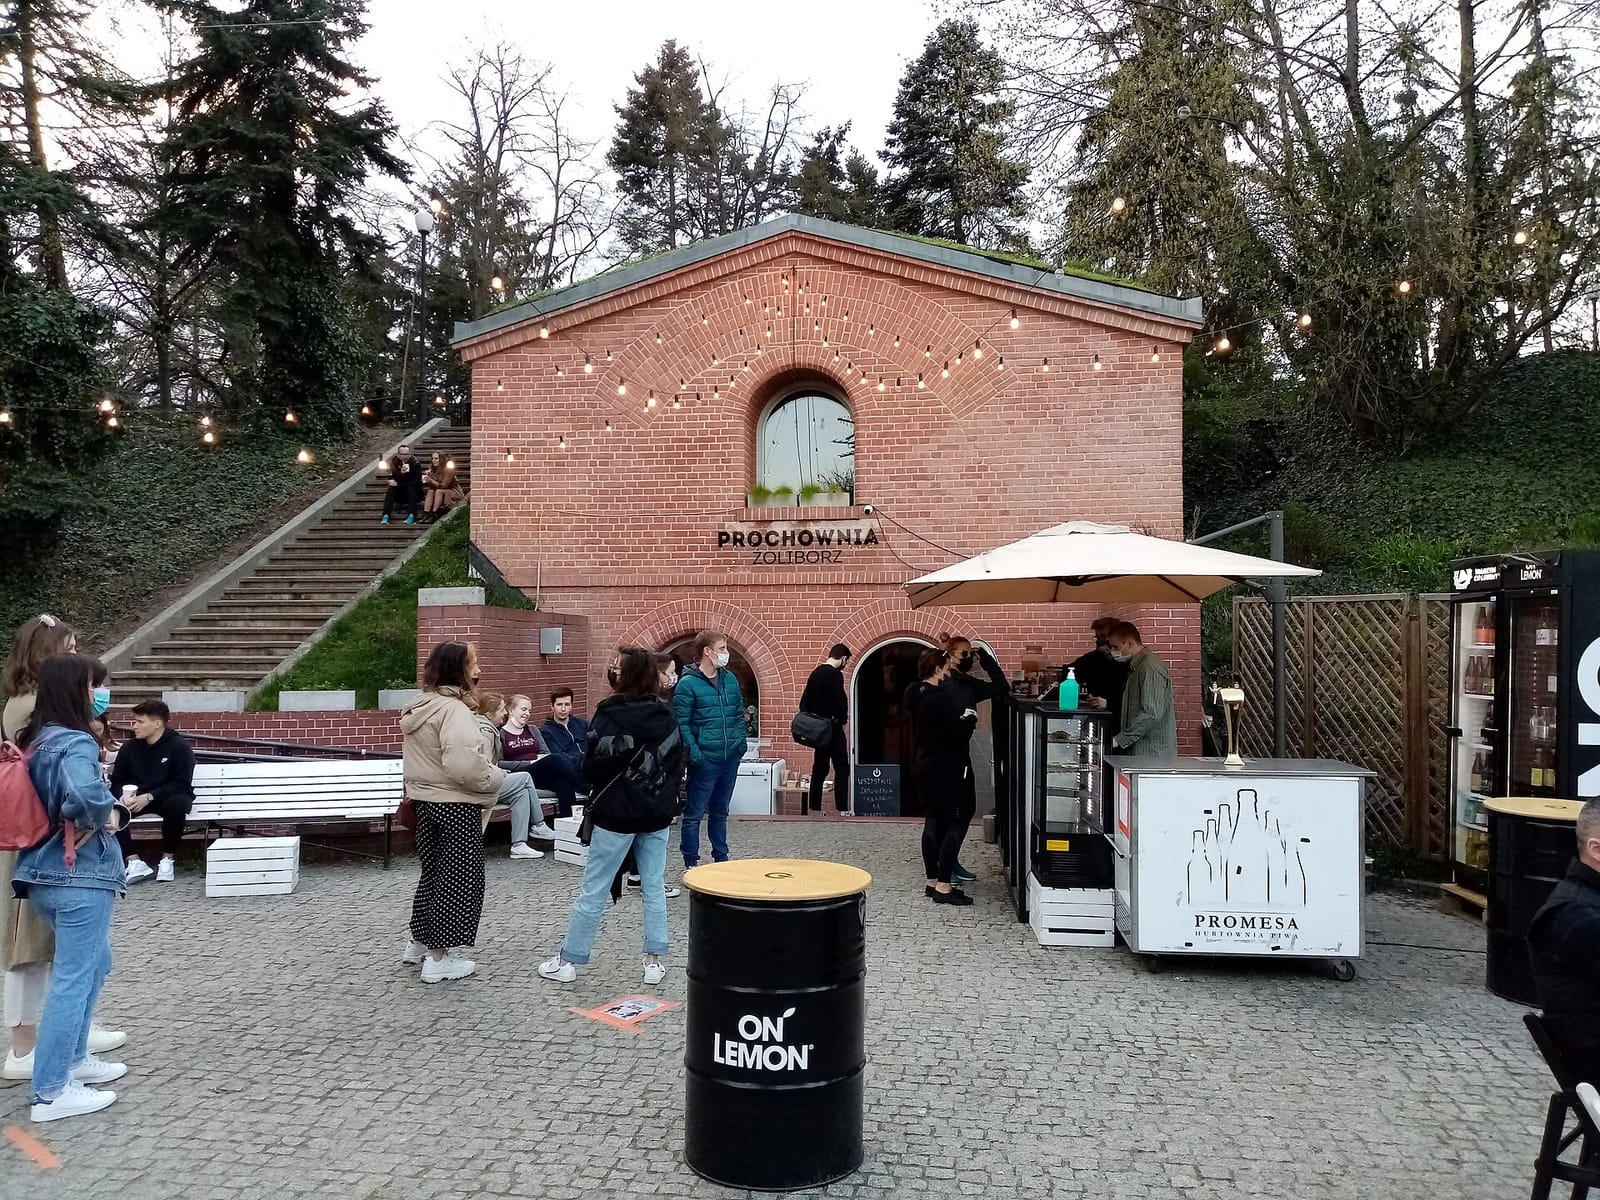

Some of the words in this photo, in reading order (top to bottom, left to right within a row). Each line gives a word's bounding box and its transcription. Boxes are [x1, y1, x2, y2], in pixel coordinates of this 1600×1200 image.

[718, 528, 879, 547] PROCHOWNIA
[752, 549, 843, 565] ŻOLIBORZ
[1194, 914, 1299, 930] PROMESA
[1195, 930, 1264, 938] HURTOWNIA
[738, 1014, 784, 1042] ON
